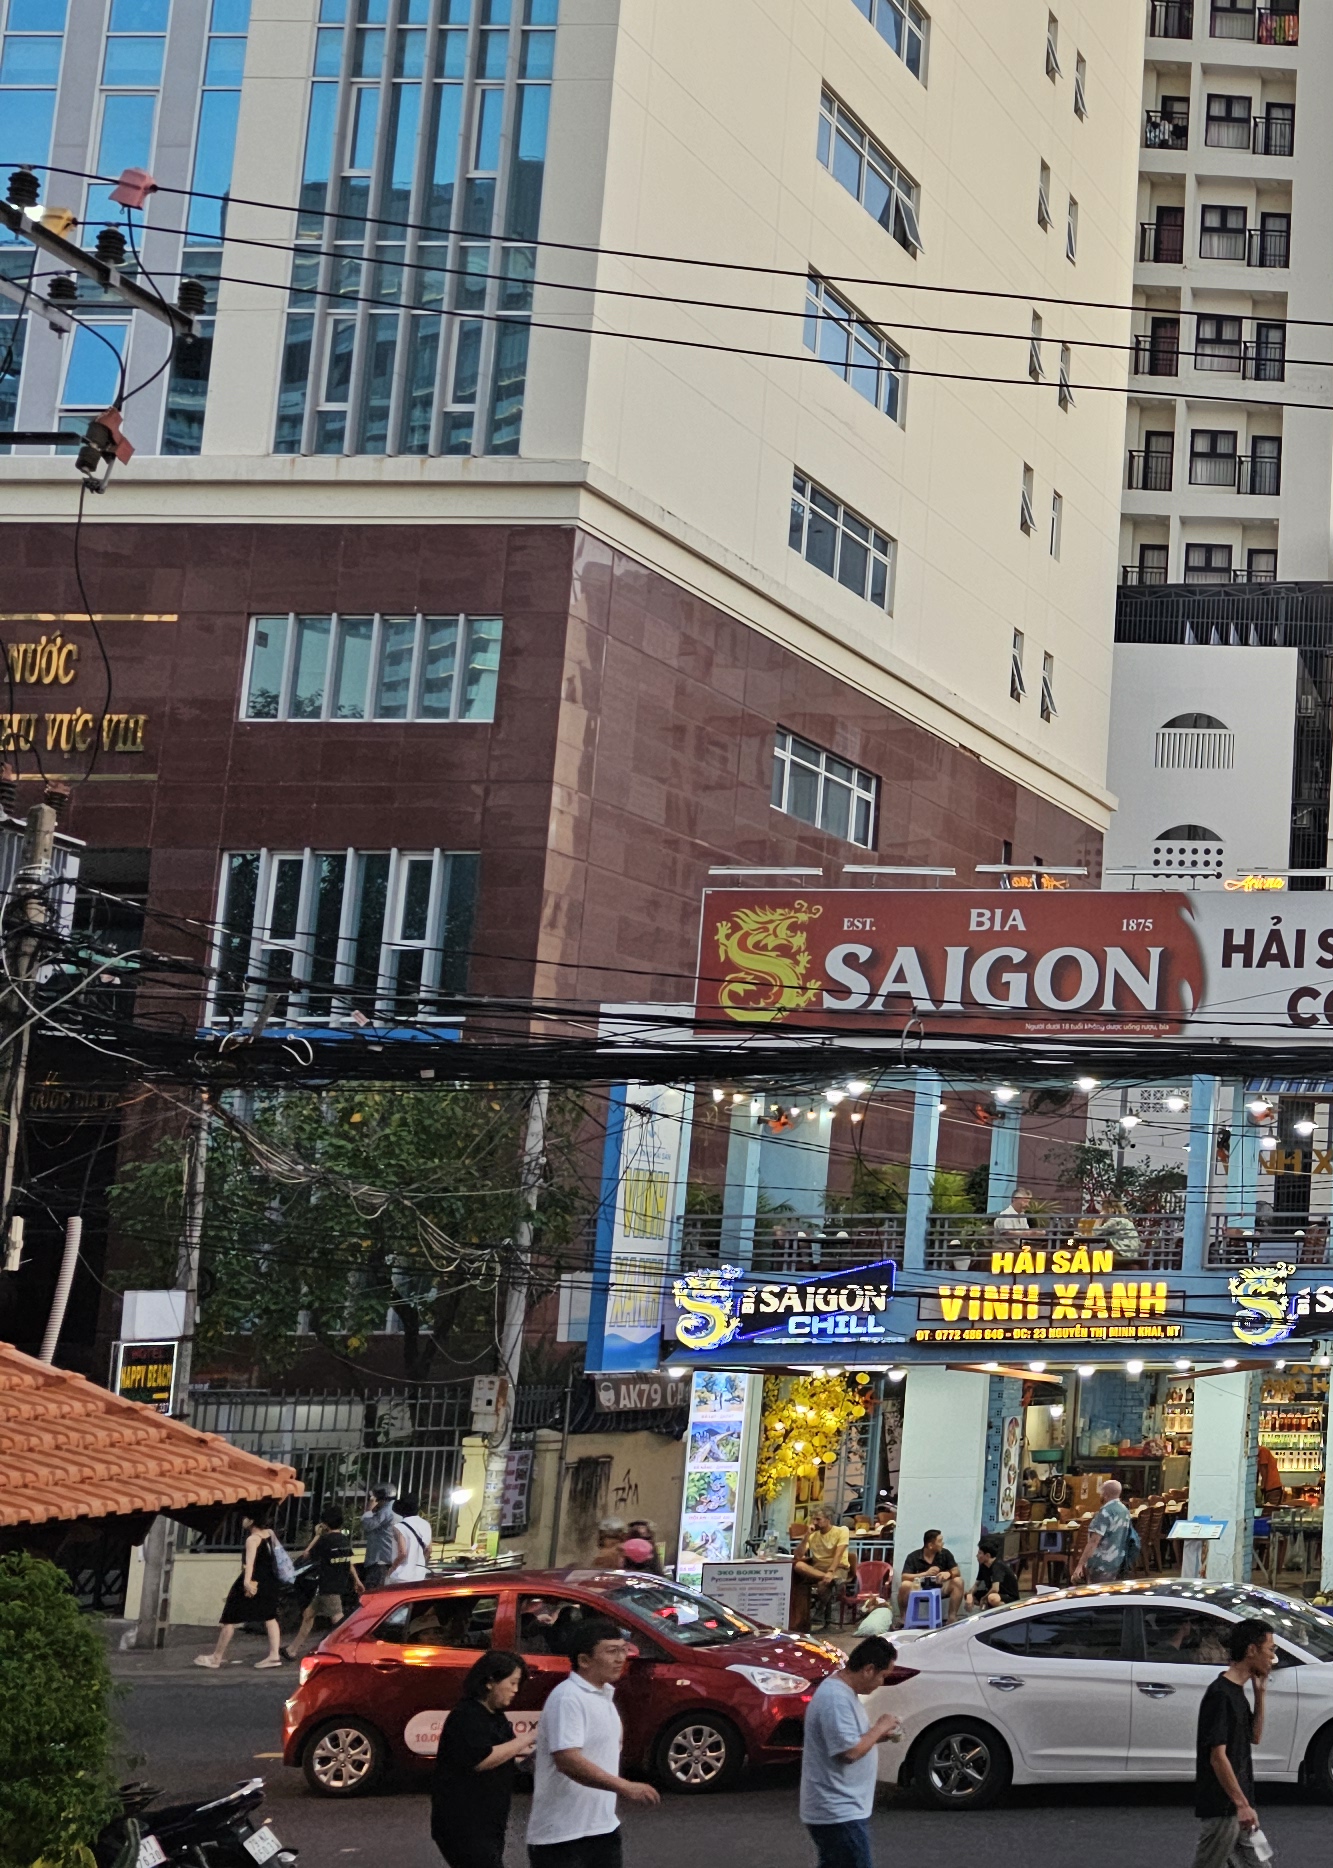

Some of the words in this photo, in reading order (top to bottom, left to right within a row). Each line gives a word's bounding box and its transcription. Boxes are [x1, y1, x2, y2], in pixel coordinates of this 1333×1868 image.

[4, 630, 78, 684] NƯỚC
[0, 714, 38, 751] HU
[45, 707, 93, 758] VỰC
[103, 714, 148, 751] VIII
[842, 918, 877, 931] EST.
[968, 908, 1027, 932] BIA
[1121, 918, 1153, 932] 1875
[1221, 915, 1307, 969] HẢI
[822, 943, 1165, 1011] SAIGON
[991, 1244, 1046, 1273] HẢI
[1051, 1244, 1114, 1274] SẢN
[758, 1284, 889, 1314] SAIGON
[1052, 1282, 1167, 1320] XANH
[788, 1314, 886, 1334] CHILL
[935, 1329, 961, 1340] 0772
[1033, 1328, 1047, 1339] 23
[120, 1364, 148, 1389] HAPPY
[148, 1363, 173, 1387] BEACH
[619, 1384, 662, 1409] AK79
